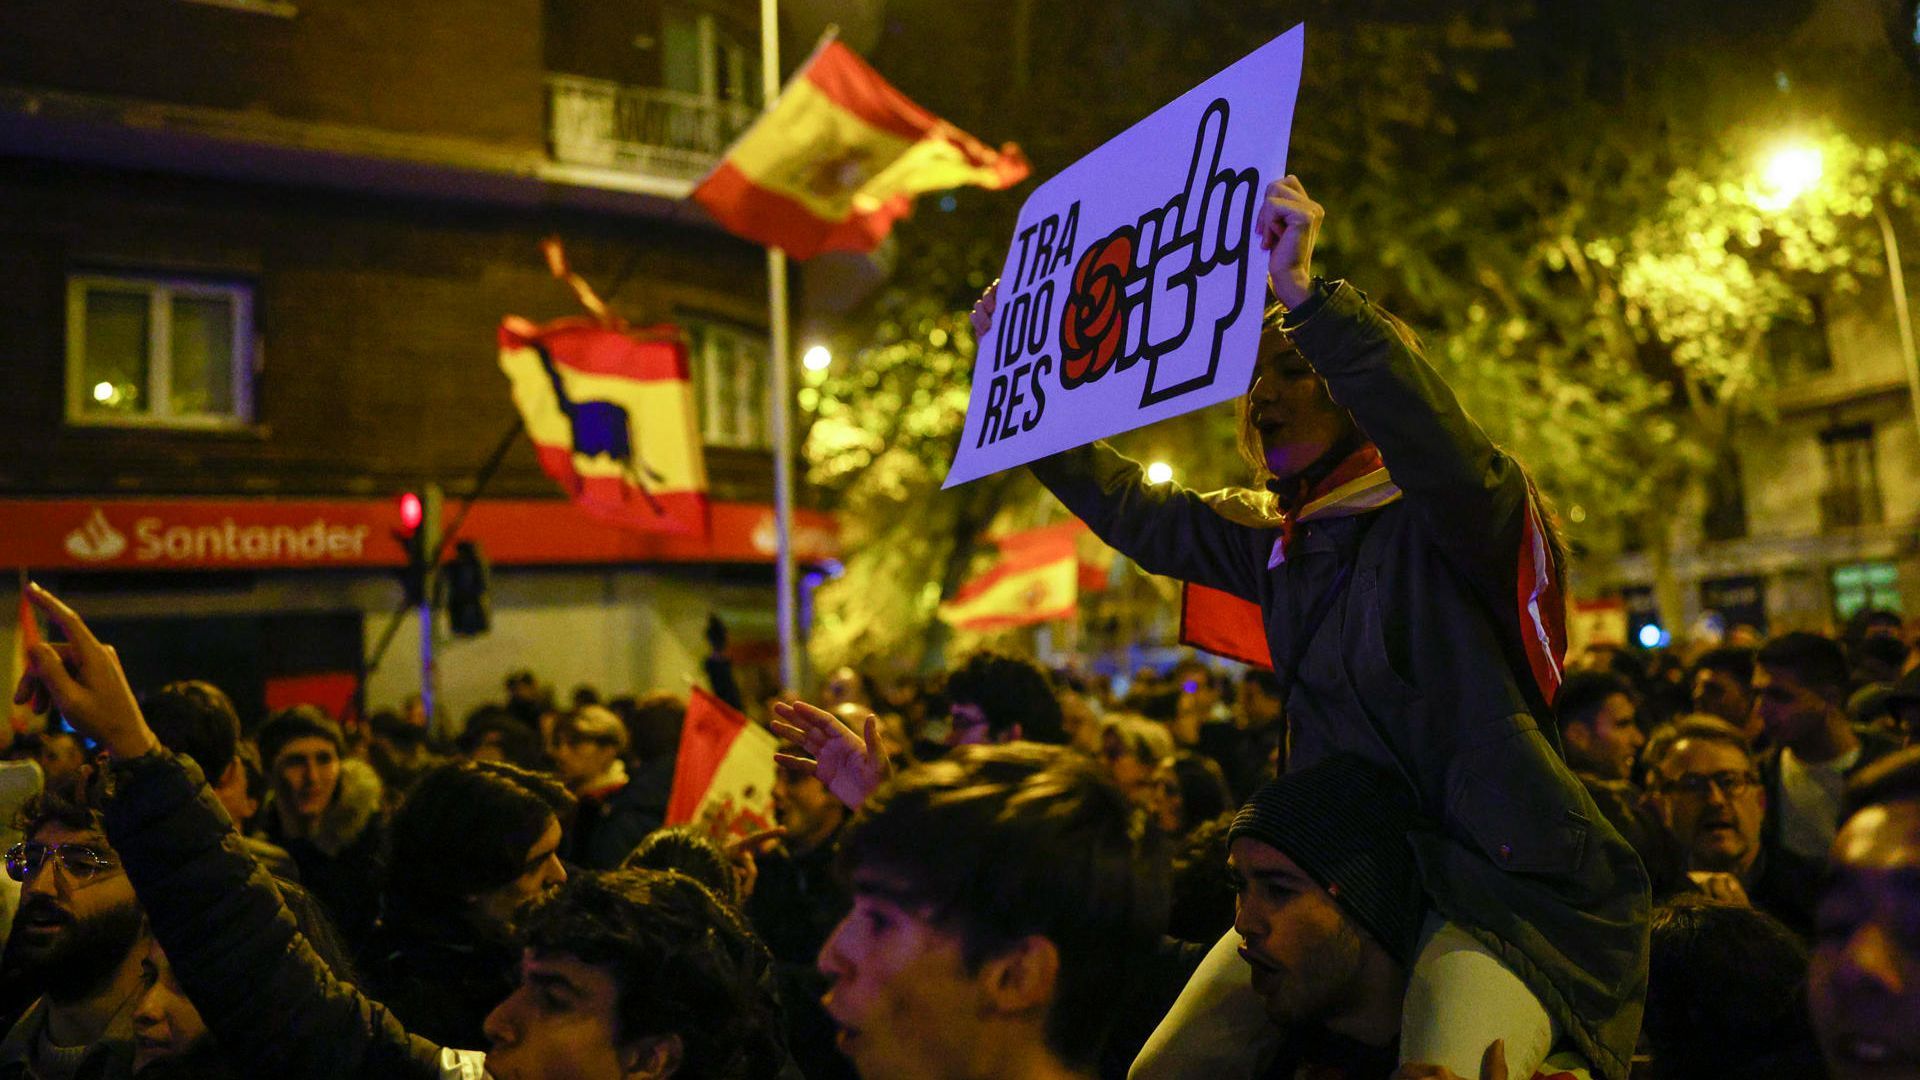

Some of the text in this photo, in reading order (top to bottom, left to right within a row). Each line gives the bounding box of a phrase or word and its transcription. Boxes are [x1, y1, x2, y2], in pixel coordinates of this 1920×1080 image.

[1012, 199, 1081, 295] TRA
[993, 279, 1055, 372] IDO
[976, 354, 1052, 449] RES
[135, 517, 368, 559] Santander
